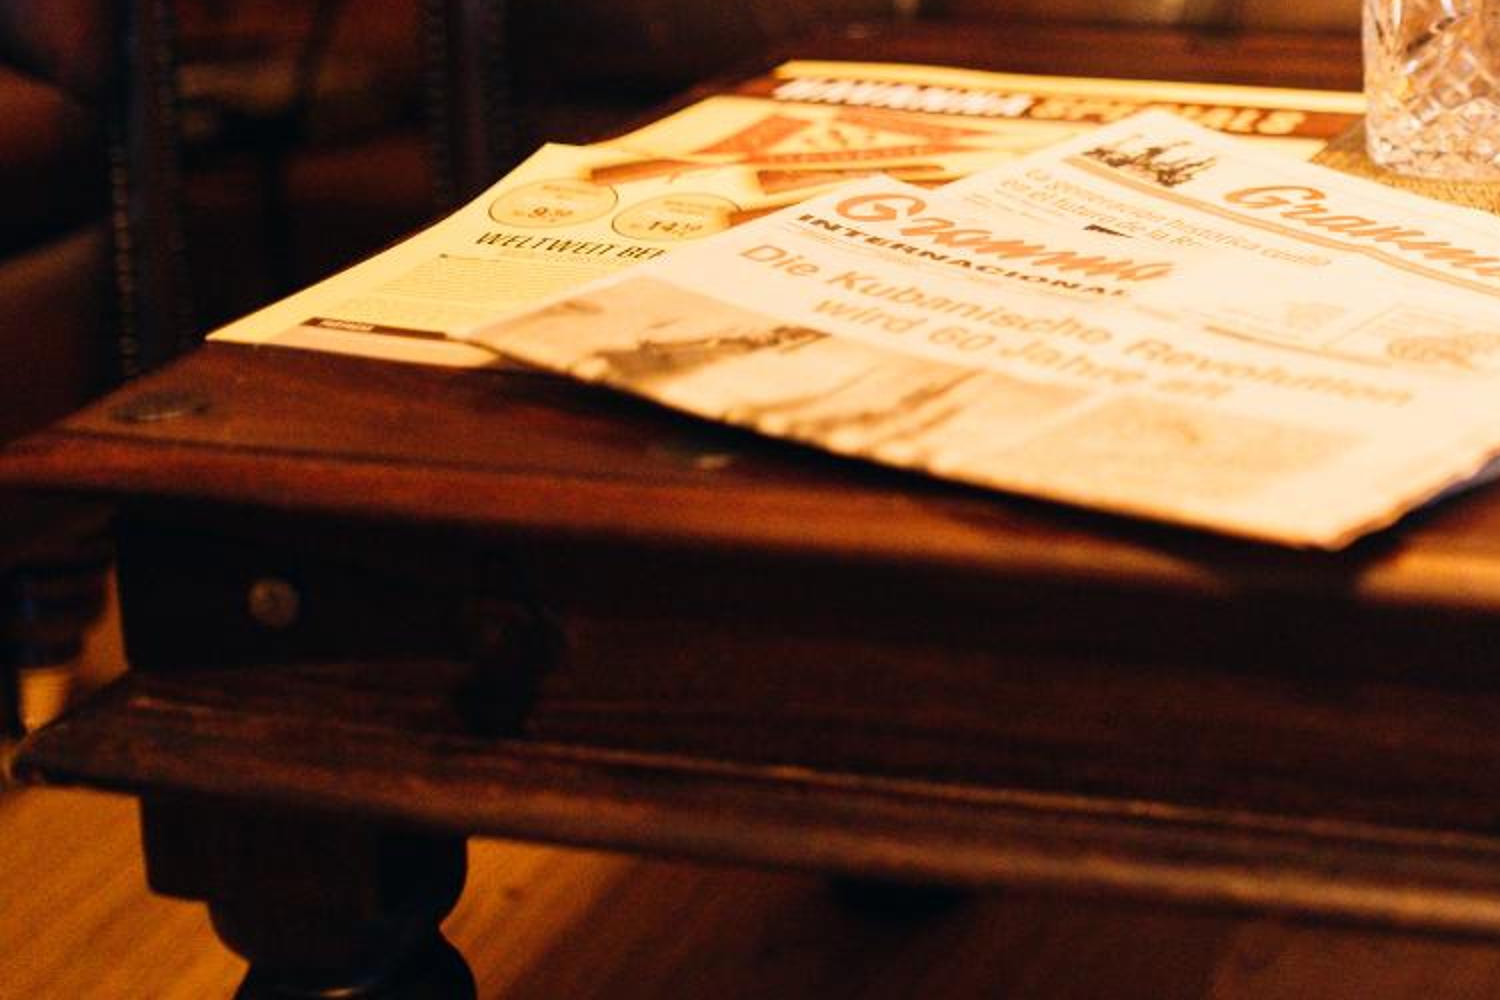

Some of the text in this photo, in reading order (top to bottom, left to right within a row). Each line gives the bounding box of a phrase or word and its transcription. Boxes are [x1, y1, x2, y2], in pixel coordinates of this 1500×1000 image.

[475, 231, 615, 256] WELTWEIT
[799, 213, 1131, 298] INTERNACIONAL
[740, 243, 820, 278] Die
[826, 270, 1113, 346] Kubanische
[812, 297, 929, 336] wird
[927, 325, 997, 352] 60
